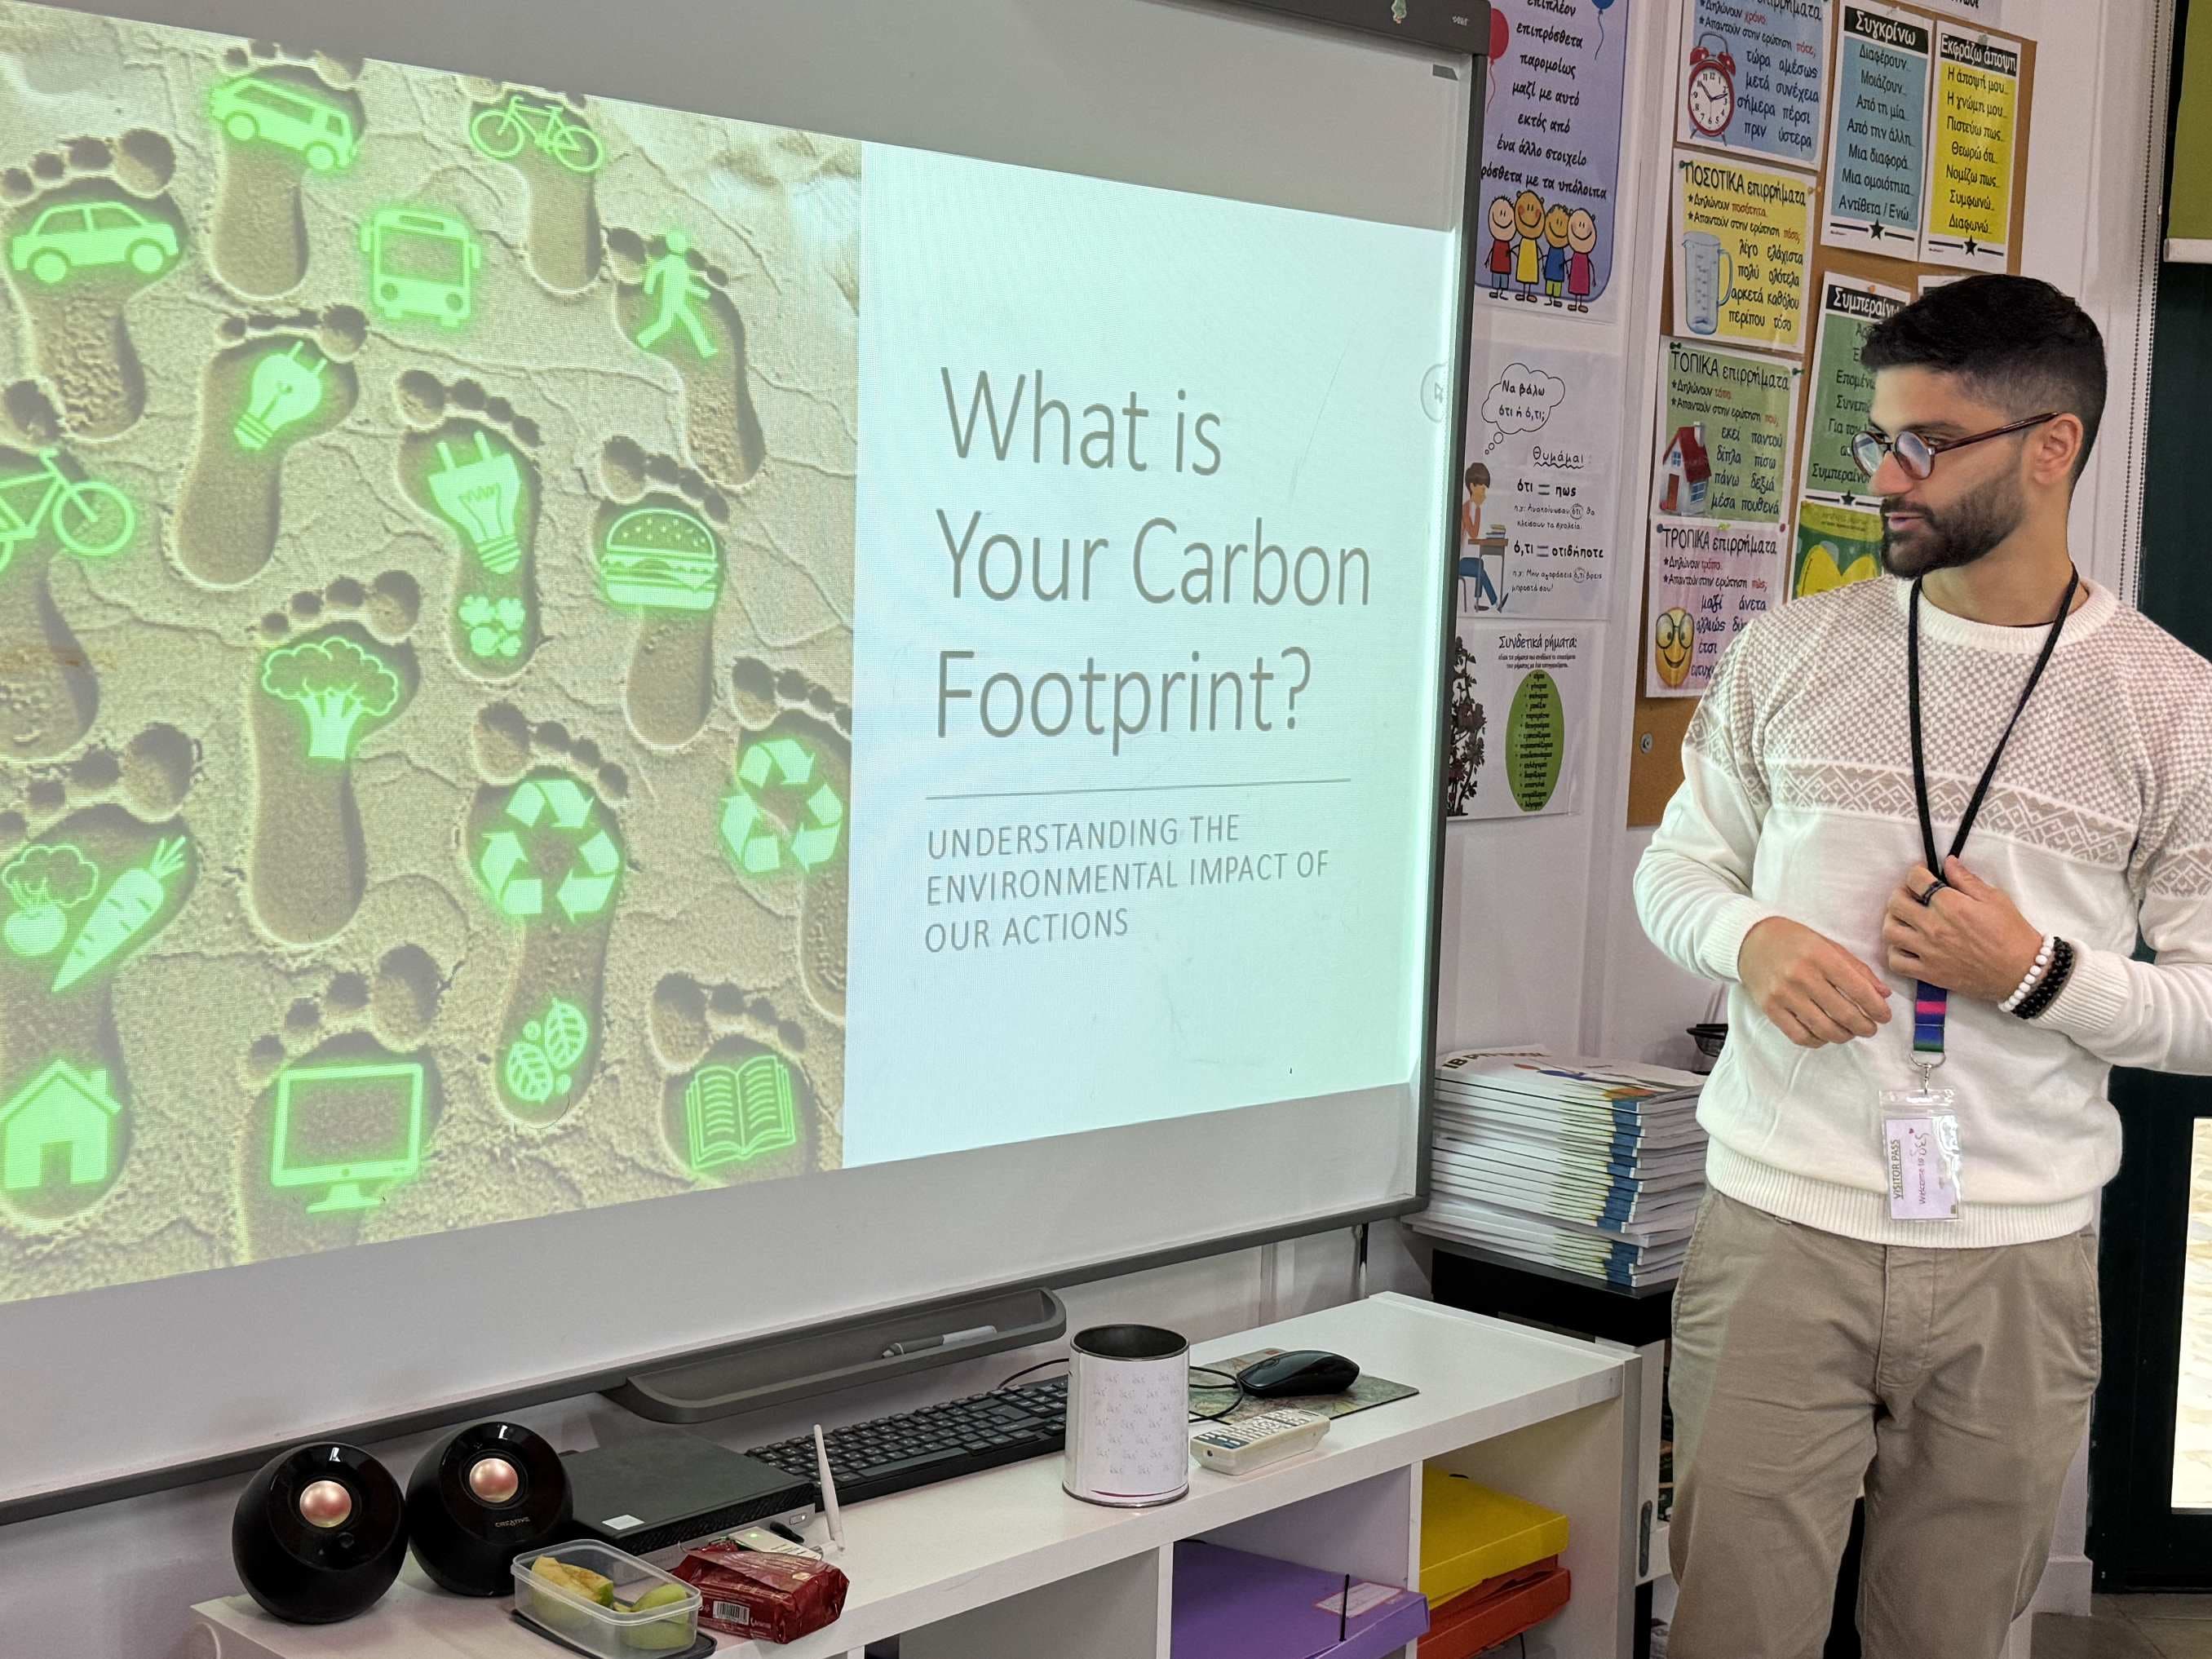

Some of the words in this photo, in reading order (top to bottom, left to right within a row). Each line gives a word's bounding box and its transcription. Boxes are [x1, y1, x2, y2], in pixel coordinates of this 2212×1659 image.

[1516, 23, 1583, 48] επιπρόσθετα
[1705, 16, 1741, 36] Απαντούν
[1742, 29, 1761, 40] στην
[1762, 33, 1793, 51] ερώτηση
[1856, 11, 1916, 46] Συγκρίνω
[1746, 49, 1771, 71] τώρα
[1779, 58, 1818, 79] αμέσως
[1941, 34, 1982, 65] Εκφράζω
[1984, 46, 2016, 73] άποψη
[1520, 53, 1577, 79] παρομοίως
[1948, 66, 1954, 81] Η
[1957, 69, 1986, 90] άποψή
[1512, 81, 1535, 100] μαζί
[1539, 88, 1552, 101] με
[1555, 91, 1579, 106] αυτό
[1745, 72, 1770, 91] μετά
[1776, 82, 1820, 104] συνέχεια
[1736, 95, 1775, 119] σήμερα
[1782, 103, 1811, 128] πέρσι
[1856, 94, 1875, 112] Από
[1948, 91, 1954, 105] Η
[1957, 95, 1985, 113] γνώμη
[1518, 113, 1546, 134] εκτός
[1551, 118, 1570, 134] από
[1847, 117, 1868, 135] Από
[1870, 126, 1887, 139] την
[1947, 116, 1982, 135] Πιστεύω
[1744, 122, 1767, 139] πριν
[1778, 126, 1812, 151] ύστερα
[1497, 134, 1515, 153] ένα
[1519, 138, 1542, 157] άλλο
[1546, 150, 1587, 167] στοιχείο
[1848, 144, 1867, 161] Μια
[1952, 141, 1982, 161] Θεωρώ
[1480, 161, 1522, 184] ρόσθετα
[1526, 174, 1539, 188] με
[1542, 177, 1555, 188] τα
[1559, 179, 1607, 200] υπόλοιπα
[1685, 165, 1745, 195] ΠΟΣΟΤΙΚΑ
[1747, 180, 1806, 206] επιρρήματα
[1842, 168, 1861, 184] Μια
[1946, 164, 1978, 185] Νομίζω
[1694, 193, 1730, 210] Δηλώνουν
[1838, 195, 1881, 216] Αντίθετα
[1693, 211, 1729, 228] Απαντούν
[1731, 219, 1749, 232] στην
[1750, 222, 1780, 237] ερώτηση
[1739, 239, 1759, 259] λίγο
[1767, 245, 1803, 265] ελάχιστα
[1737, 264, 1759, 281] πολύ
[1768, 268, 1800, 288] ολότελα
[1731, 287, 1763, 305] αρκετά
[1767, 290, 1799, 310] καθόλου
[1728, 309, 1765, 330] περίπου
[1671, 351, 1719, 378] ΤΟΠΙΚΑ
[1723, 365, 1790, 392] επιρρήματα
[1502, 380, 1515, 393] Να
[1520, 383, 1545, 396] βάλω
[1677, 379, 1713, 396] Δηλώνουν
[940, 366, 1149, 472] What
[1175, 389, 1221, 476] is
[1499, 405, 1513, 417] ότι
[1516, 407, 1522, 418] ή
[1525, 406, 1545, 422] ό,τι;
[1677, 398, 1711, 413] Απαντούν
[1713, 403, 1729, 417] στην
[1731, 407, 1761, 422] ερώτηση
[1722, 426, 1741, 441] εκεί
[1751, 431, 1783, 448] παντού
[1829, 418, 1843, 434] Για
[1716, 445, 1741, 465] δίπλα
[1754, 453, 1776, 470] πίσω
[1517, 478, 1533, 493] ότι
[1714, 470, 1740, 487] πάνω
[1750, 472, 1775, 494] δεξιά
[1711, 492, 1736, 510] μέσα
[1741, 497, 1780, 515] πουθενά
[1514, 540, 1533, 556] ό,τι
[1551, 545, 1604, 559] οτιδήποτε
[1662, 529, 1710, 551] ΤΡΟΠΙΚΑ
[1713, 533, 1777, 557] επιρρήματα
[936, 507, 1109, 602] Your
[1133, 516, 1370, 606] Carbon
[1669, 555, 1699, 570] Δηλώνουν
[1669, 573, 1698, 587] Απαντούν
[1715, 577, 1747, 591] ερώτηση
[1701, 594, 1723, 613] μαζί
[1739, 595, 1767, 611] άνετα
[1697, 617, 1726, 634] αλλιώς
[1498, 633, 1542, 649] Συνδετικά
[1545, 635, 1577, 652] ρήματα:
[1698, 639, 1717, 653] έτσι
[938, 646, 1312, 757] Footprint?
[928, 817, 1178, 860] UNDERSTANDING
[1189, 813, 1240, 844] THE
[927, 859, 1178, 906] ENVIRONMENTAL
[1189, 853, 1288, 887] IMPACT
[1297, 850, 1329, 878] OF
[925, 919, 989, 953] OUR
[1002, 907, 1129, 947] ACTIONS
[1891, 1139, 1901, 1161] PASS
[1891, 1164, 1902, 1199] VISITOR
